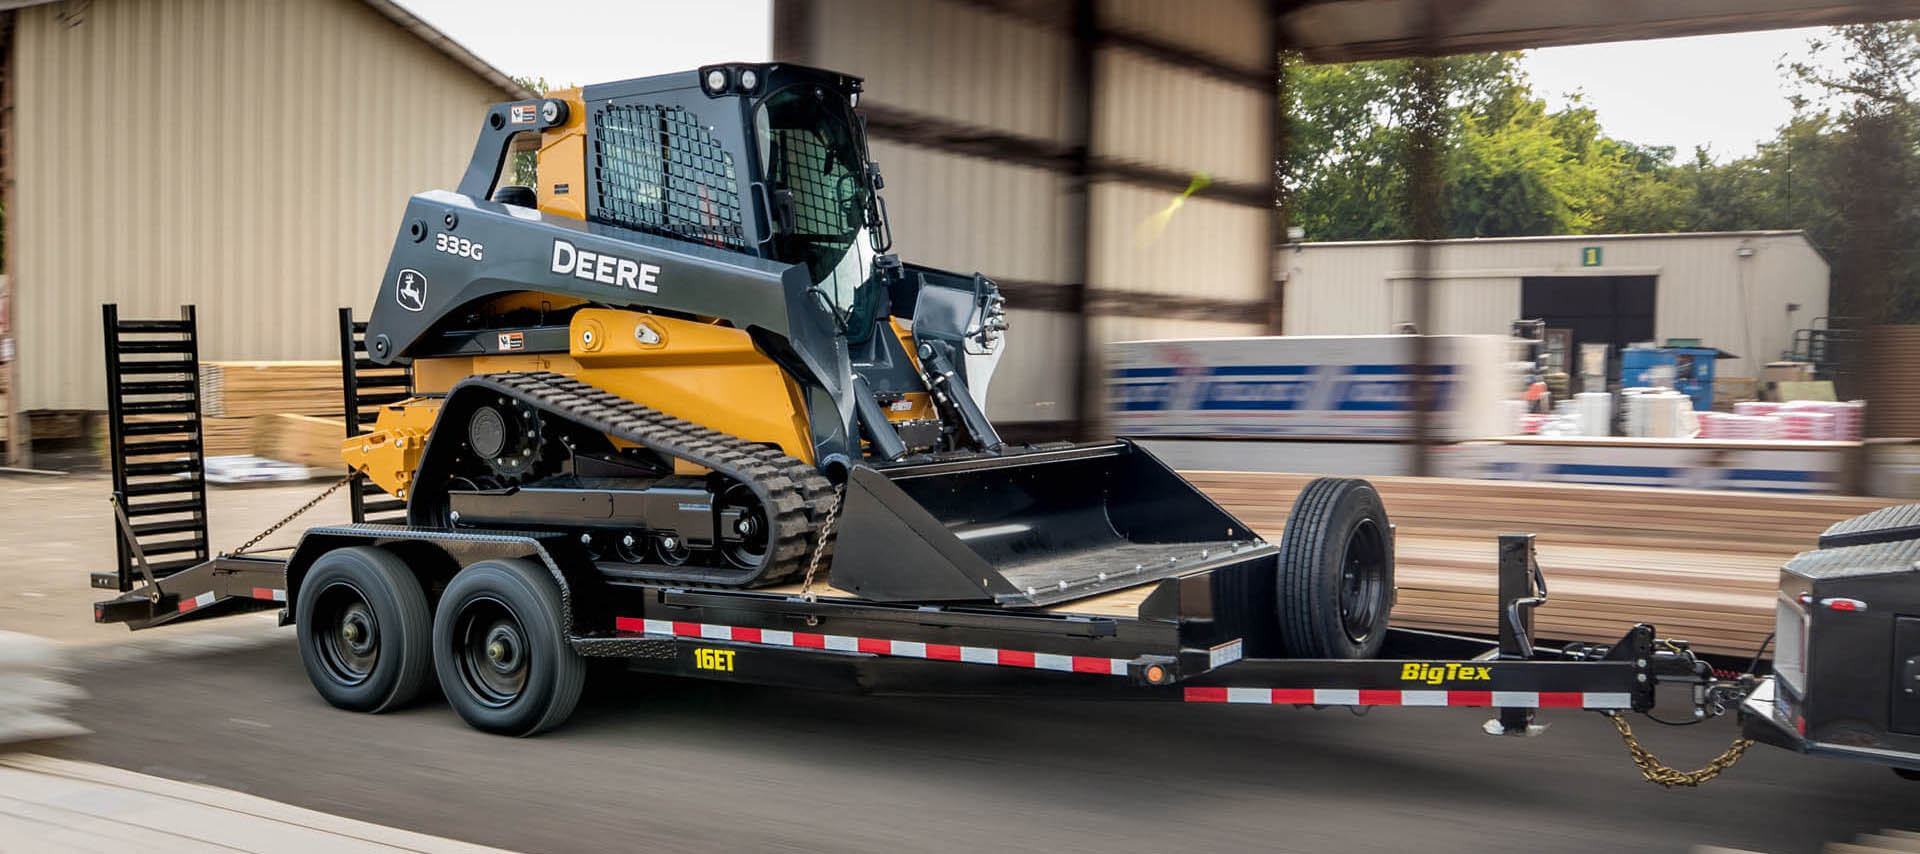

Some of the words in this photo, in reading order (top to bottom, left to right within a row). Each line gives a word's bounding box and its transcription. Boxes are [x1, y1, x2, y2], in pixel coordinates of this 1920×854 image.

[435, 233, 483, 261] 333G
[1586, 248, 1597, 265] 1
[551, 240, 661, 294] DEERE
[694, 648, 736, 672] 16ET
[1400, 663, 1492, 685] BigTex
